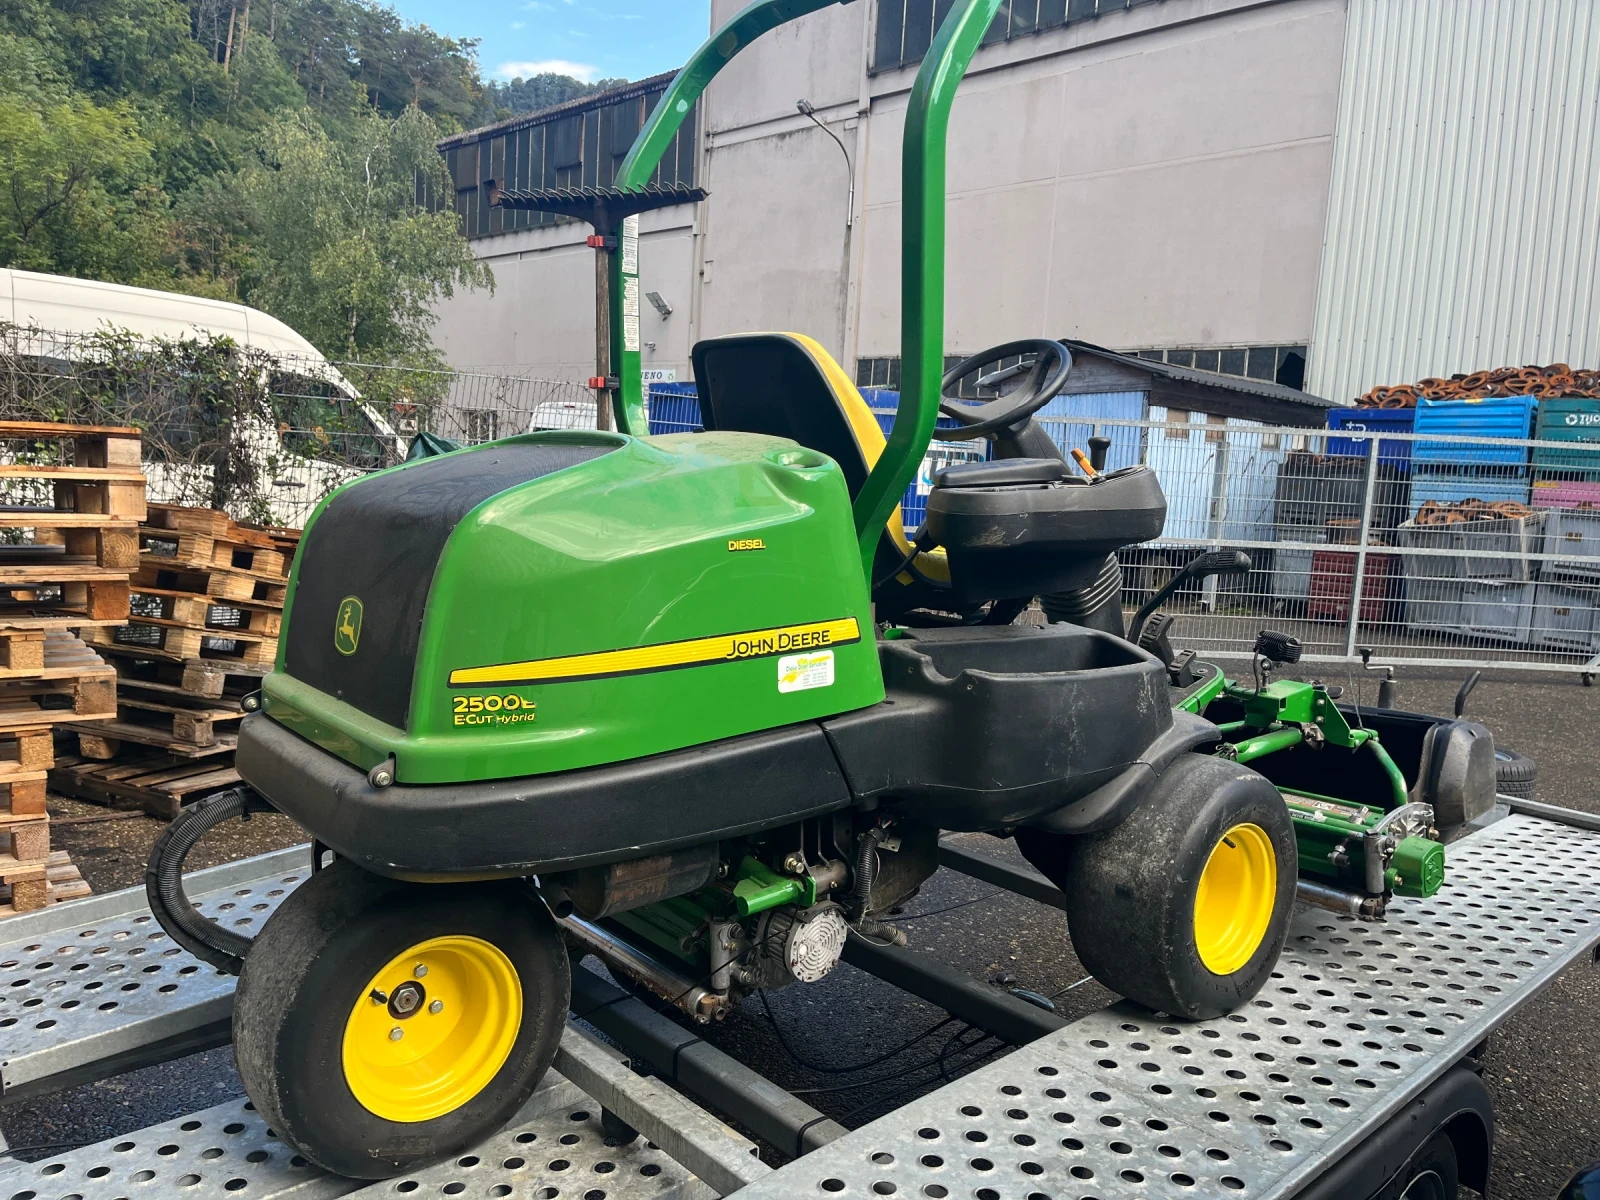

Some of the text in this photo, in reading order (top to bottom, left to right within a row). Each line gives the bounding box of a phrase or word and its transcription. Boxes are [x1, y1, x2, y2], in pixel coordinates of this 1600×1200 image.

[728, 538, 767, 552] DIESEL
[726, 629, 831, 657] JOHN DEERE
[496, 712, 536, 725] Hybrid
